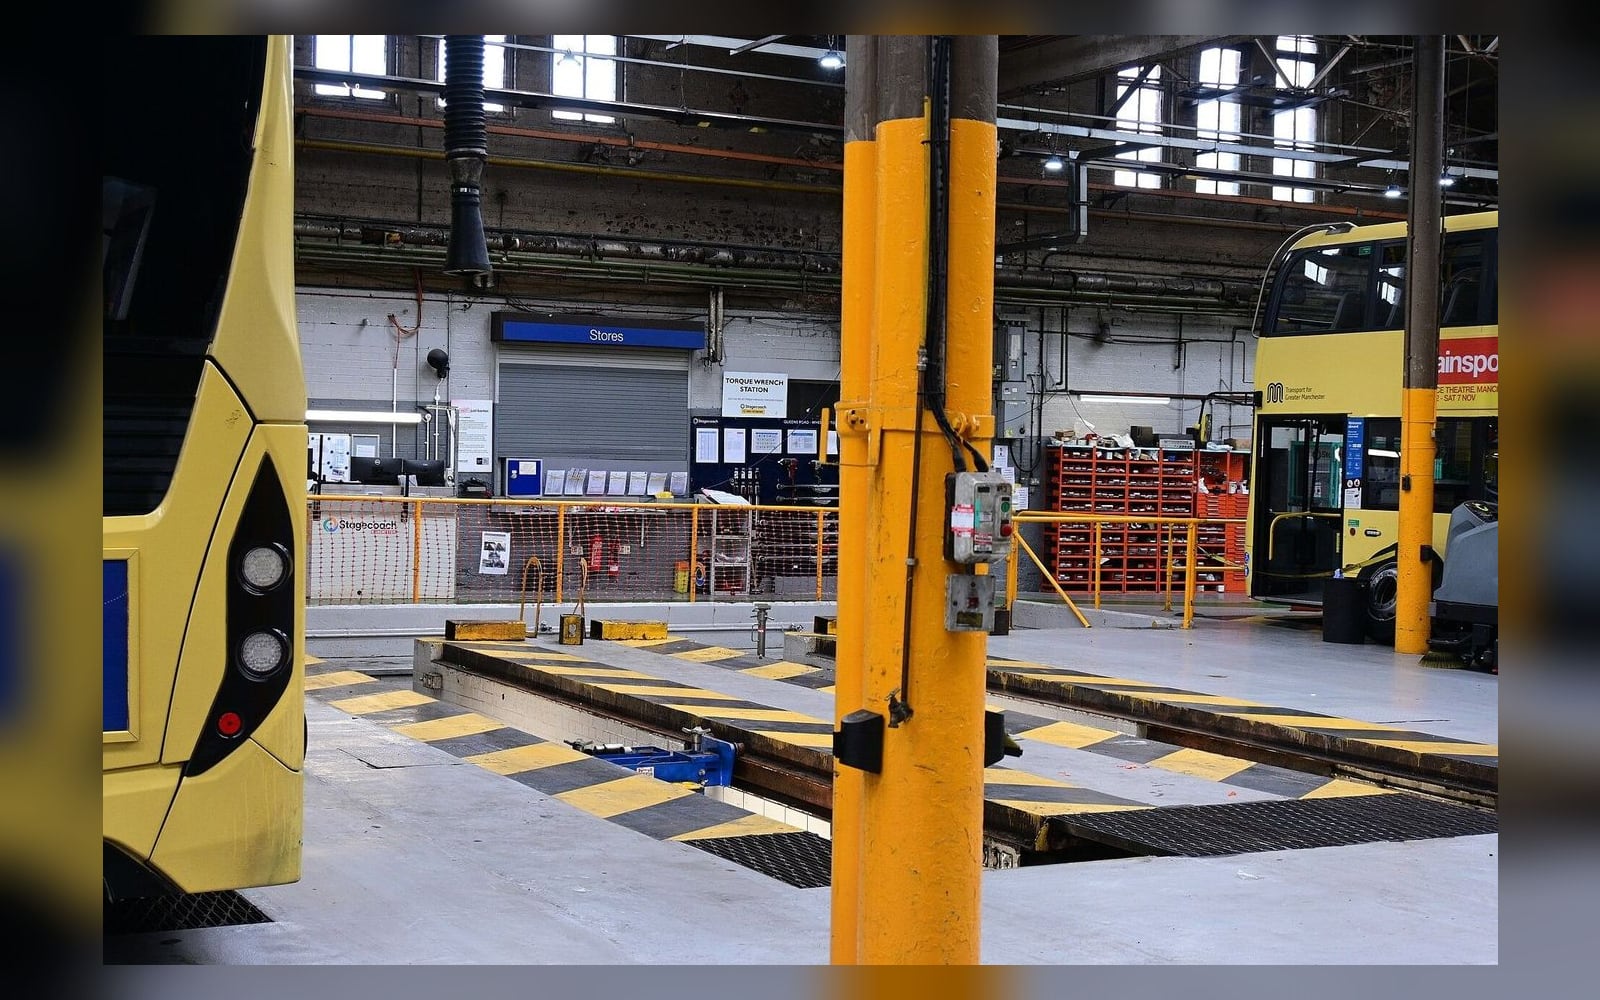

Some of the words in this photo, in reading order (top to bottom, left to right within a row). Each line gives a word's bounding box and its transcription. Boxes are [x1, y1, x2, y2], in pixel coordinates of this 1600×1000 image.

[590, 329, 624, 342] Stores
[754, 378, 784, 386] WRENCH
[339, 519, 397, 531] Stagecoach
